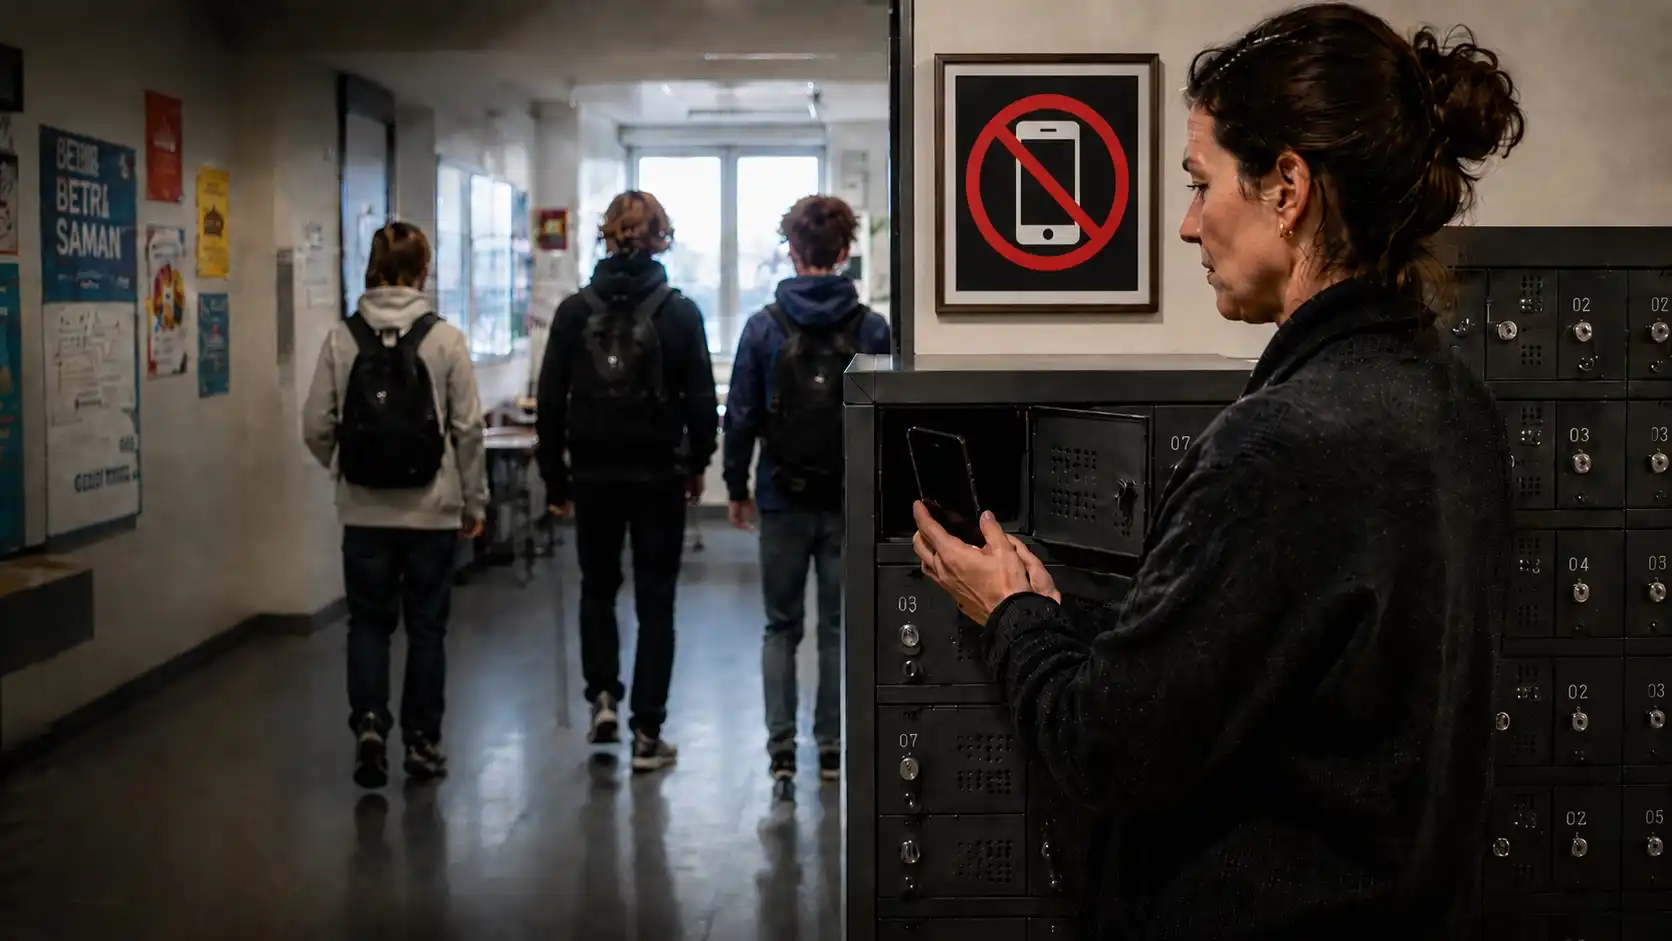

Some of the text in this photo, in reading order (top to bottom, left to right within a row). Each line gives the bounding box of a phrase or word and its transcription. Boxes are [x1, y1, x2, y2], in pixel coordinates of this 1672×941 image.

[56, 217, 121, 260] SAMAN
[1572, 297, 1591, 312] 02
[1651, 297, 1669, 312] 02
[1569, 427, 1590, 443] 03
[1651, 426, 1668, 442] 03
[1170, 435, 1191, 451] 07
[1568, 556, 1589, 572] 04
[1648, 555, 1667, 571] 03
[898, 596, 917, 613] 03
[1568, 684, 1588, 700] 02
[1648, 683, 1665, 698] 03
[899, 733, 919, 748] 07
[1566, 811, 1587, 826] 02
[1645, 809, 1664, 825] 05
